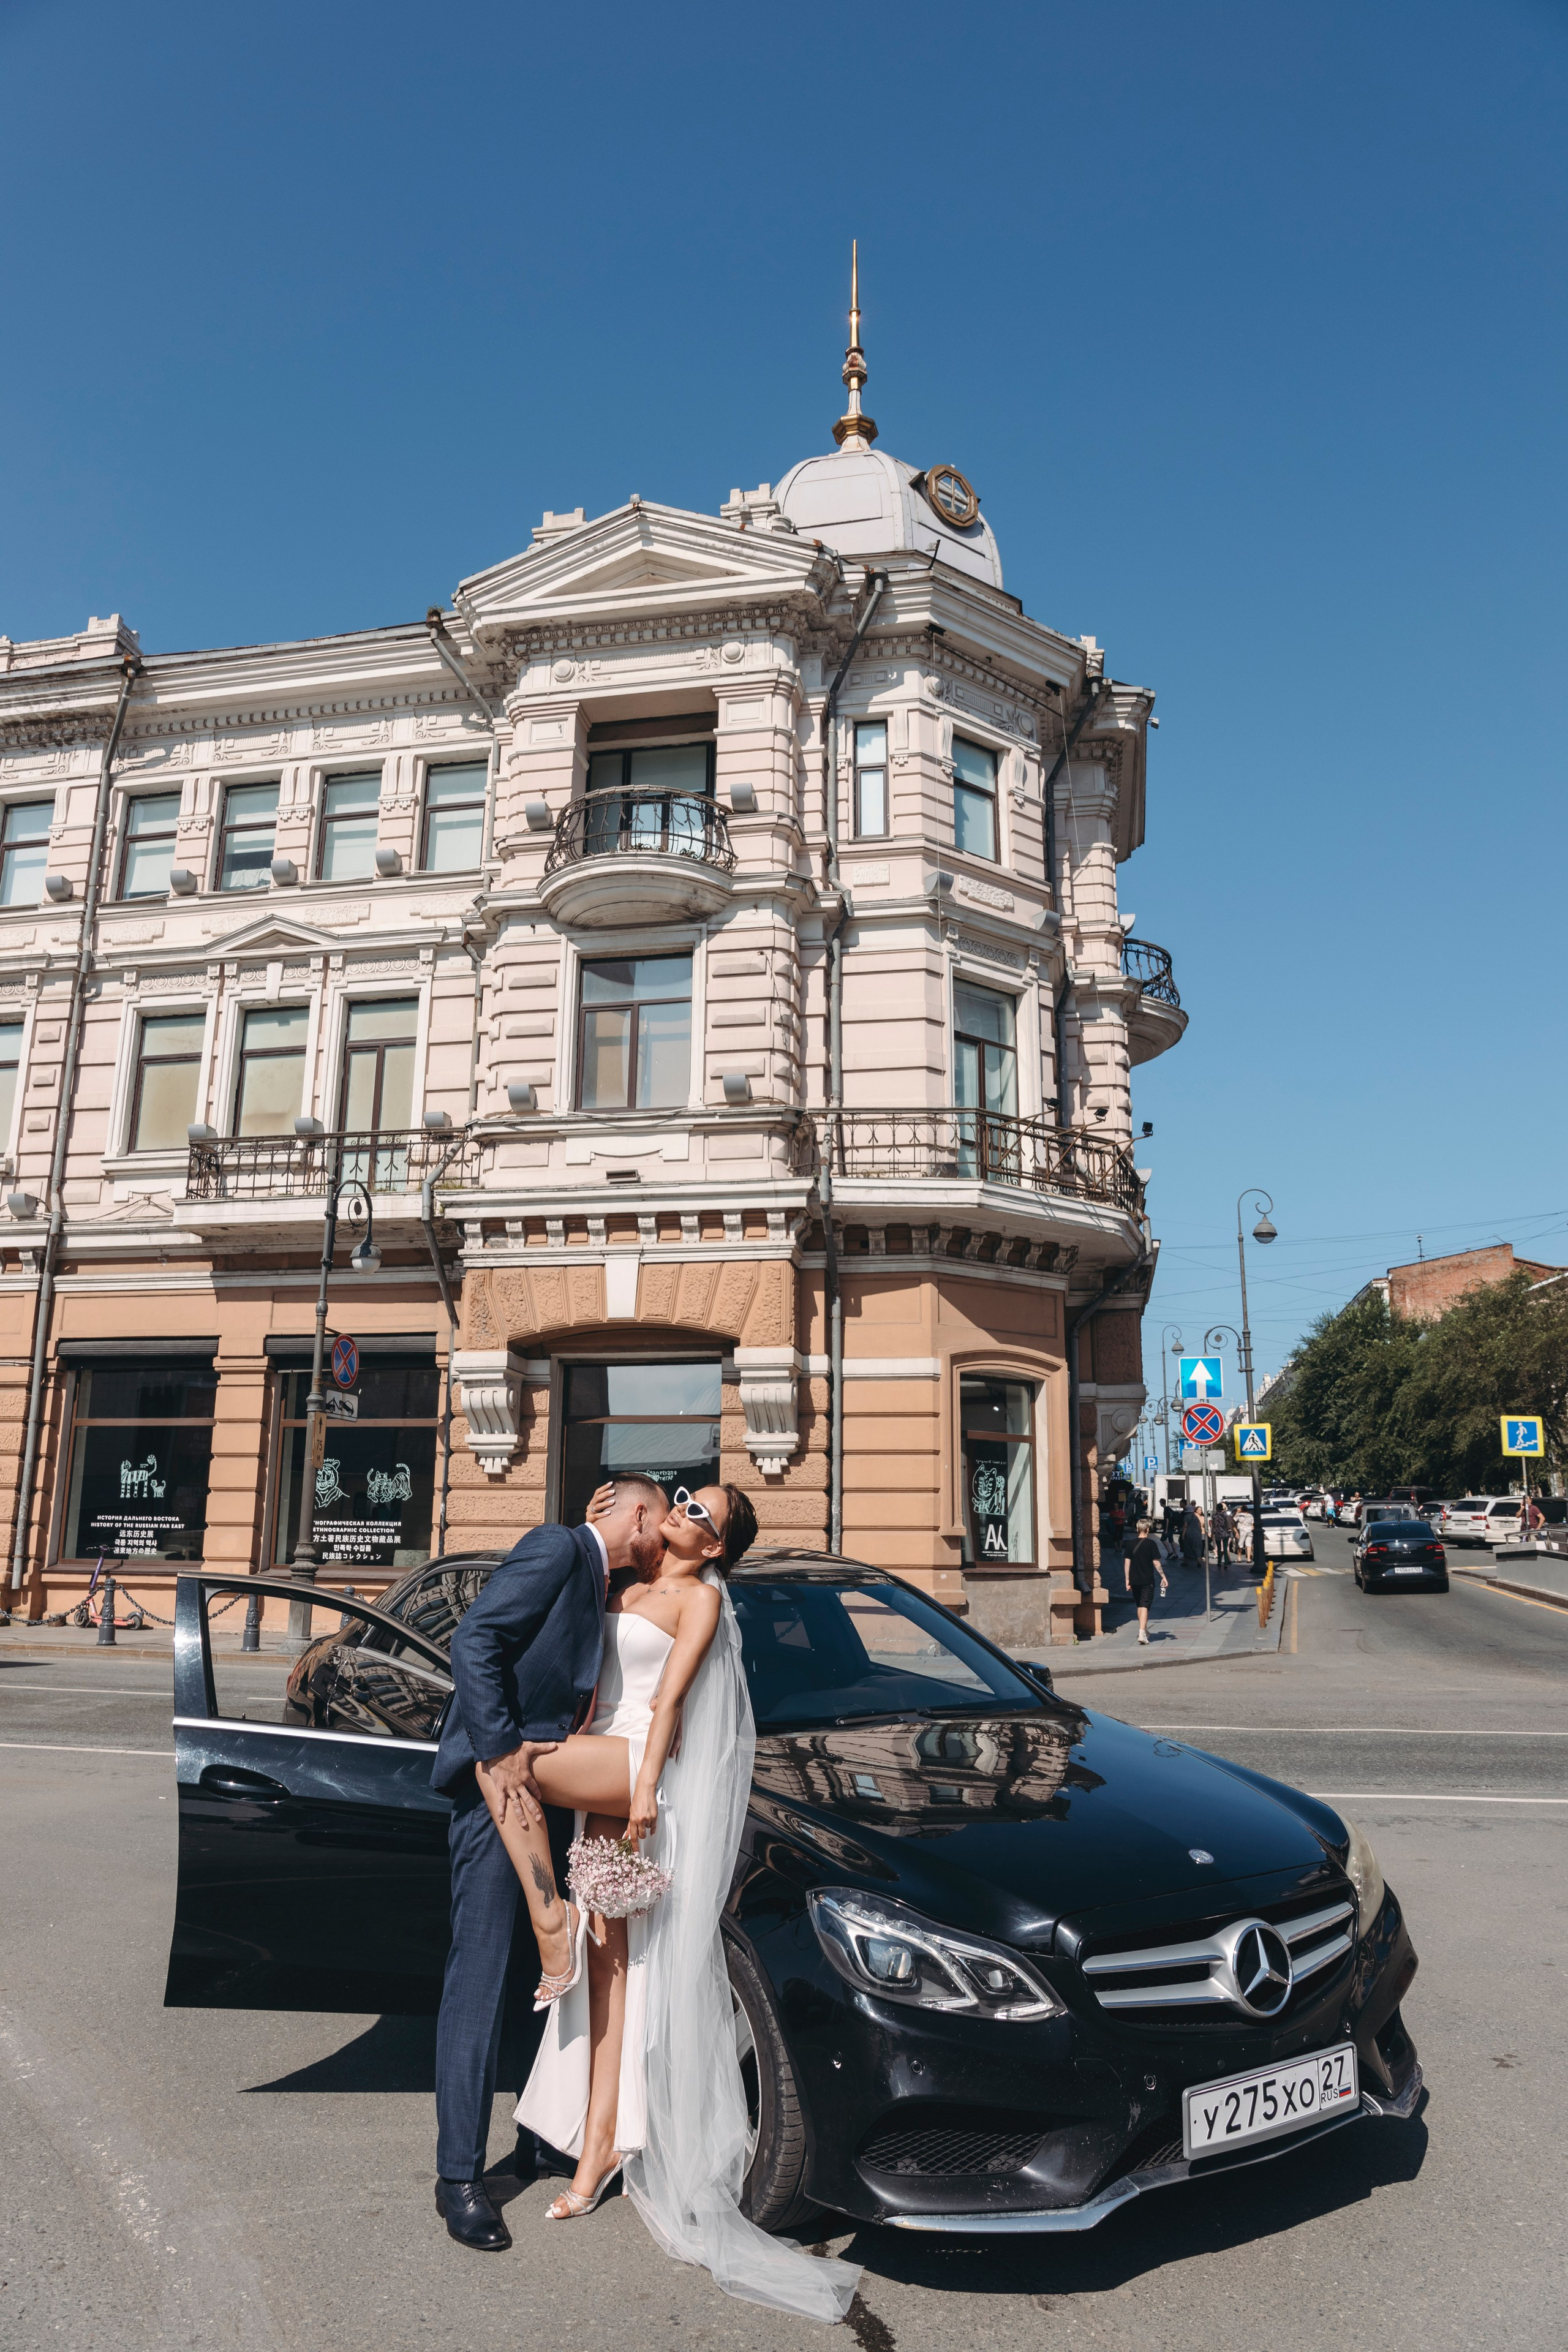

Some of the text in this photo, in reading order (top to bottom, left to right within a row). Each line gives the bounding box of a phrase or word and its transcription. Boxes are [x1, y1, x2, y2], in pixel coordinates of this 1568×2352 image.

[317, 1439, 322, 1451] 75
[119, 1529, 154, 1538] 远东历史展
[313, 1534, 401, 1544] 方土著民族历史文物藏品展
[1321, 2055, 1344, 2091] 27
[1321, 2088, 1338, 2104] RUS
